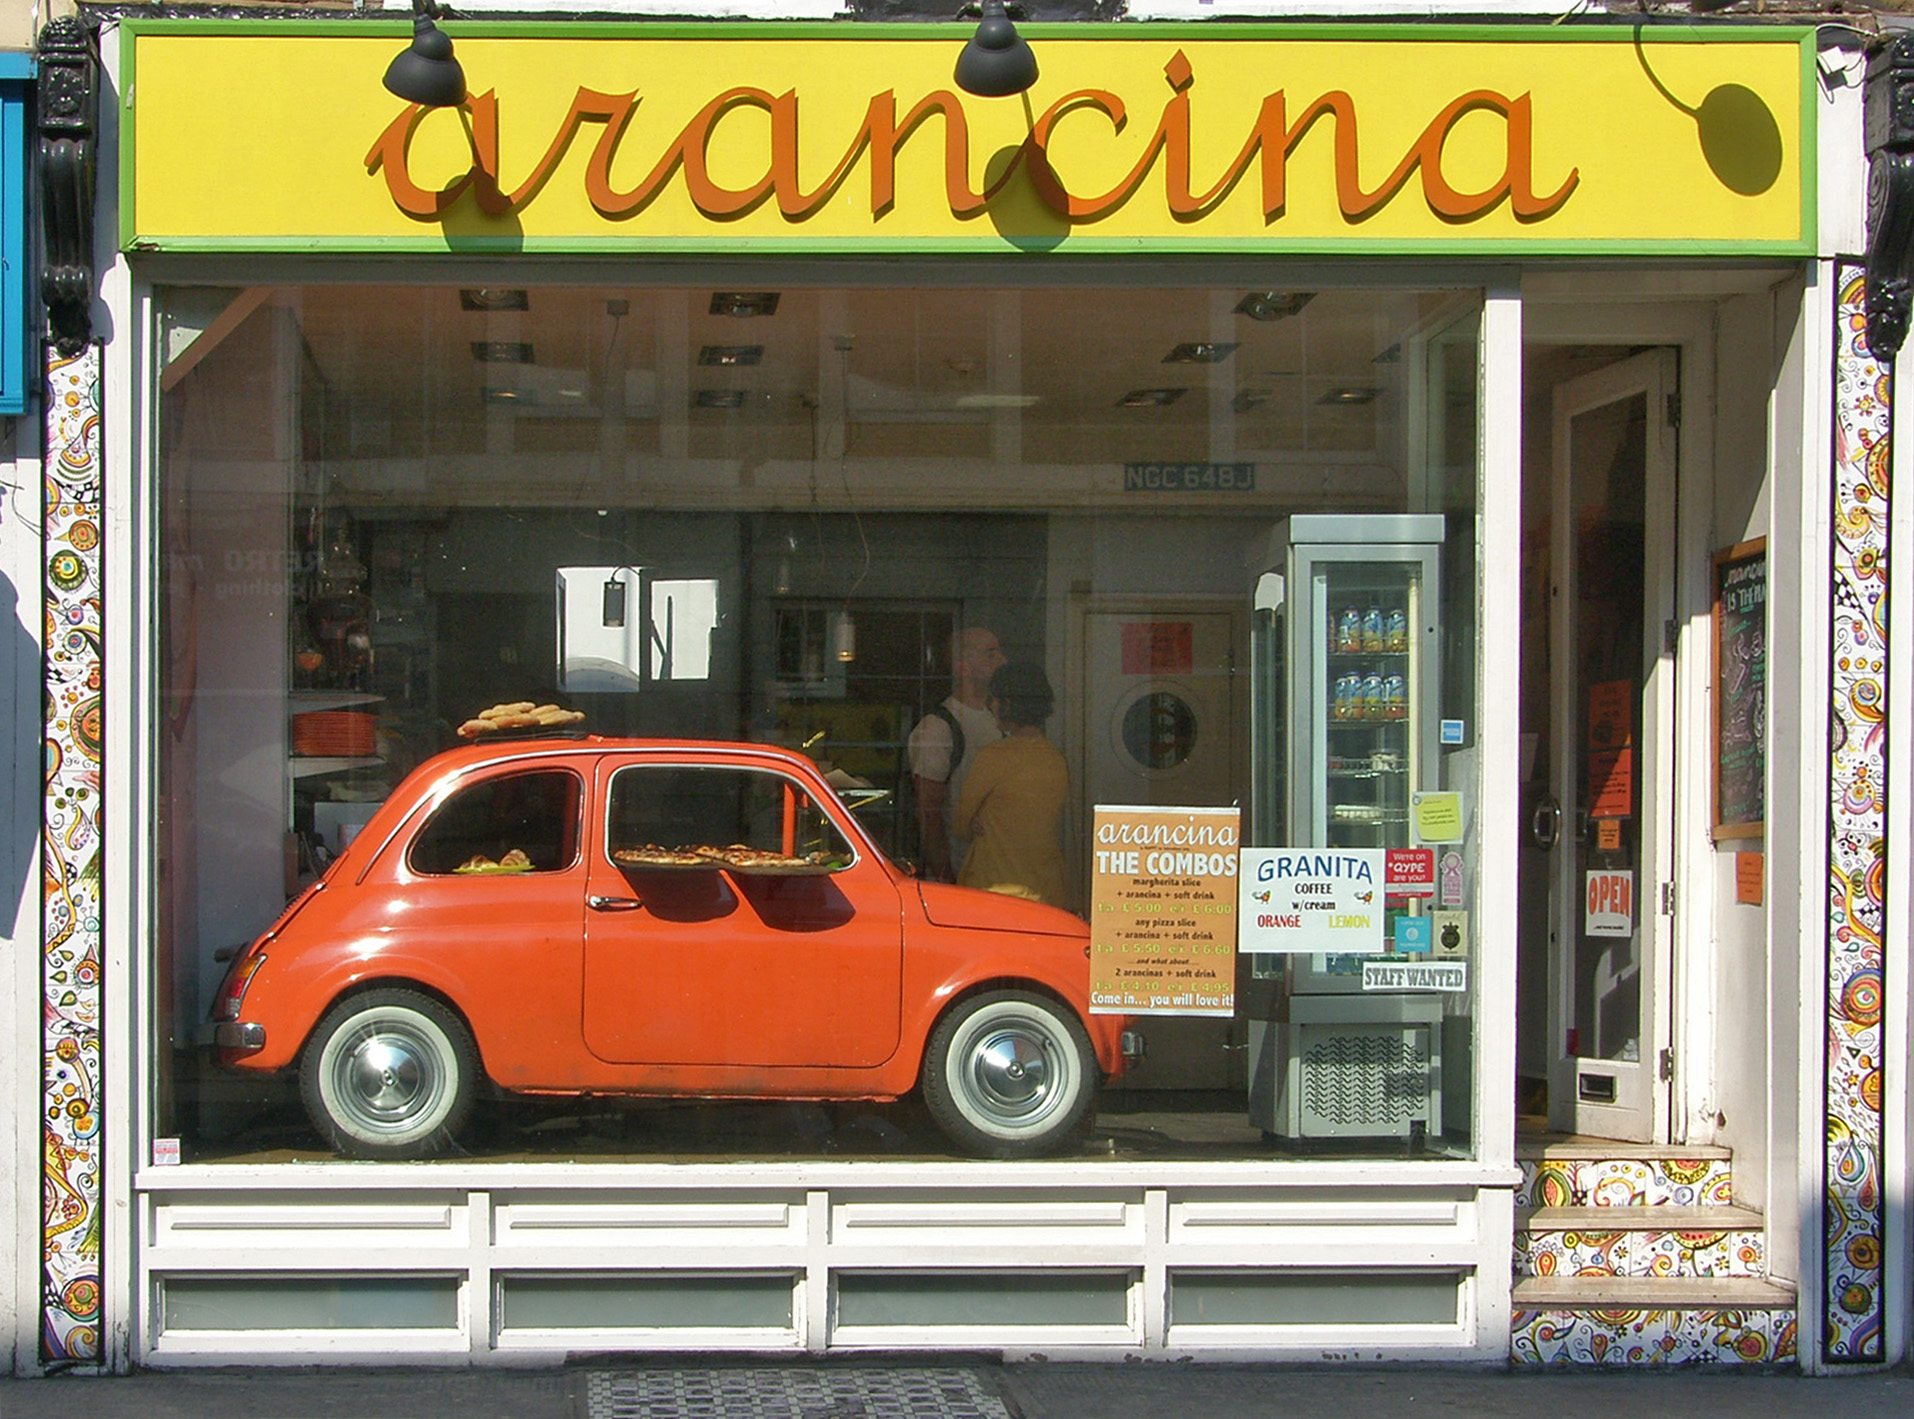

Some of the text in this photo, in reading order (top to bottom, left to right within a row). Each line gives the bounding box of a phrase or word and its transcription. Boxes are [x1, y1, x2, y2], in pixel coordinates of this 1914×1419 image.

[362, 48, 1582, 225] arancina
[1126, 466, 1252, 488] NGC 648J
[1097, 815, 1239, 846] arancina
[1096, 851, 1237, 877] THE COMBOS
[1415, 853, 1427, 862] on
[1257, 855, 1373, 885] GRANITA
[1132, 878, 1201, 888] margherita slice
[1392, 874, 1407, 882] are
[1294, 882, 1333, 895] COFFEE
[1125, 891, 1162, 900] arancina
[1173, 892, 1190, 900] soft
[1192, 892, 1215, 900] drink
[1588, 875, 1630, 918] OPEN
[1291, 900, 1336, 912] w/cream
[1135, 918, 1197, 928] any pizza slice
[1257, 914, 1302, 928] ORANGE
[1328, 915, 1371, 928] LEMON
[1124, 931, 1161, 939] arancina
[1172, 931, 1190, 940] soft
[1191, 931, 1214, 940] drink
[1115, 968, 1121, 977] 2
[1123, 969, 1164, 977] arancinas
[1175, 969, 1192, 978] soft
[1194, 969, 1217, 978] drink
[1364, 967, 1464, 987] STAFF WANTED
[1091, 992, 1121, 1005] Come
[1150, 995, 1170, 1008] you
[1173, 993, 1193, 1006] will
[1196, 993, 1219, 1006] love
